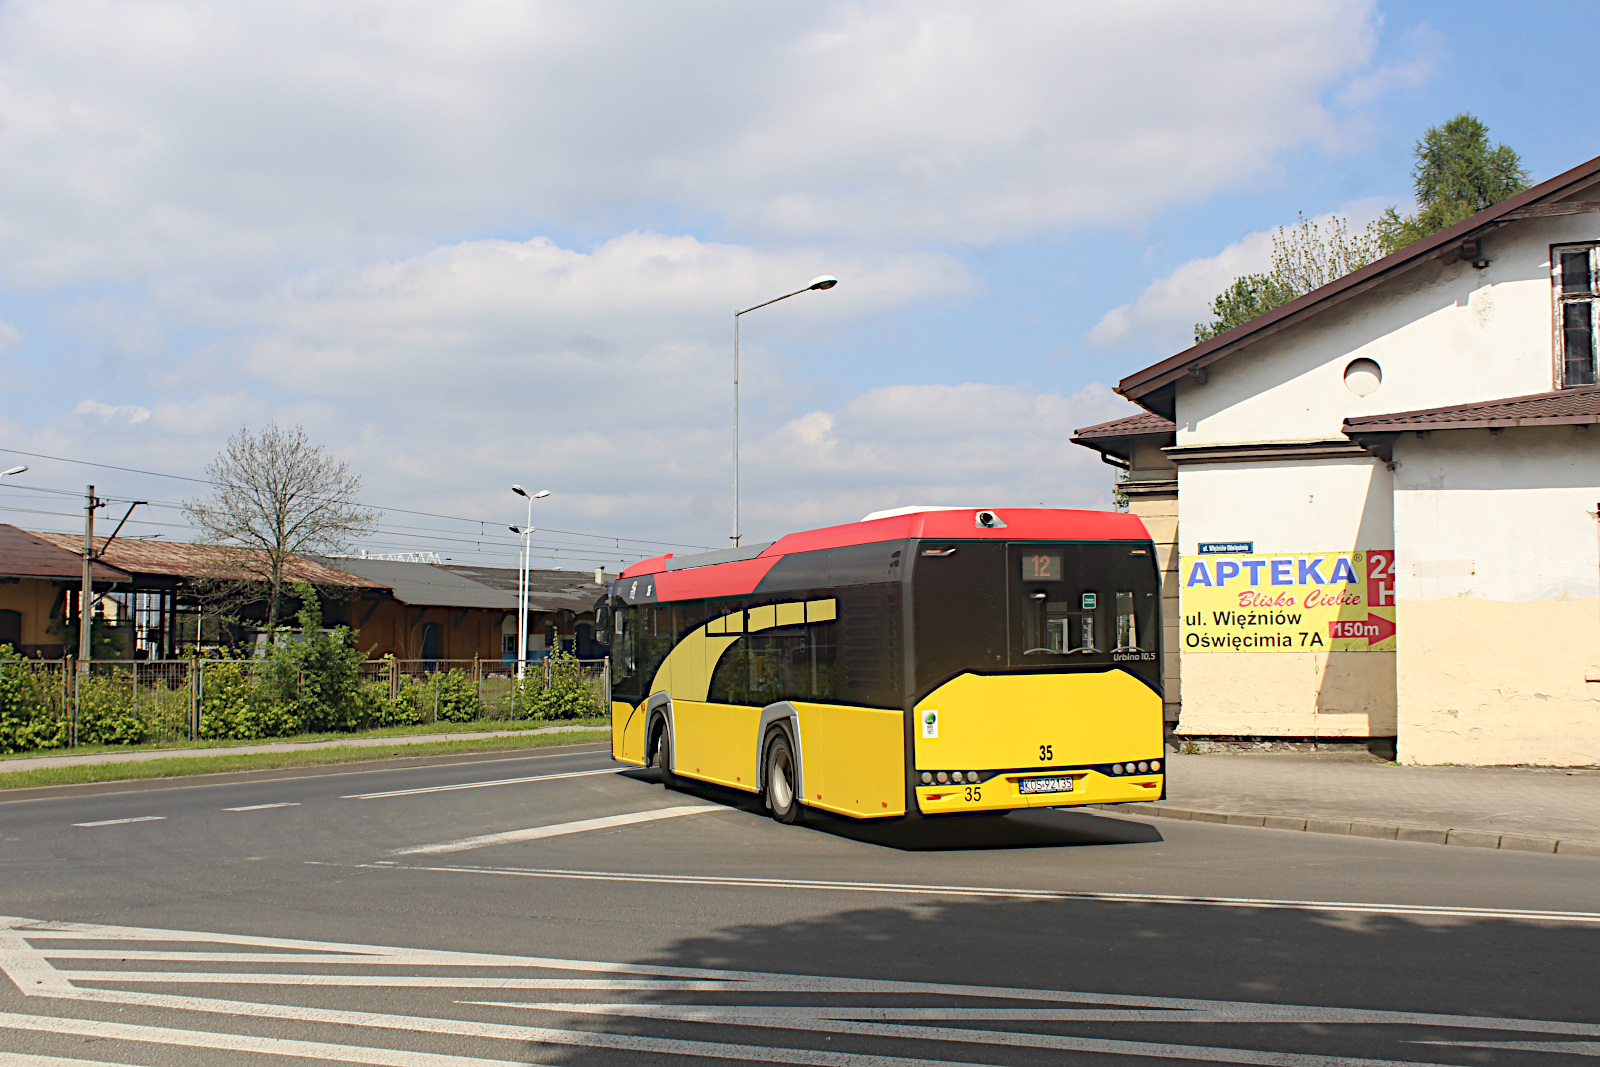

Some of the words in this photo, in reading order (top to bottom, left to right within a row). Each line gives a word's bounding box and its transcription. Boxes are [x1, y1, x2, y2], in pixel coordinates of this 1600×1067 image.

[1031, 554, 1051, 577] 12
[1237, 590, 1297, 608] Blisko
[1303, 588, 1363, 609] Ciebie
[1186, 611, 1207, 626] ul.
[1213, 610, 1302, 629] Więźniów
[1334, 622, 1380, 637] 150m
[1186, 633, 1292, 650] Oświęcimia
[1299, 632, 1324, 647] 7A
[1113, 653, 1140, 661] Urbino
[1039, 745, 1053, 761] 35
[964, 787, 982, 802] 35
